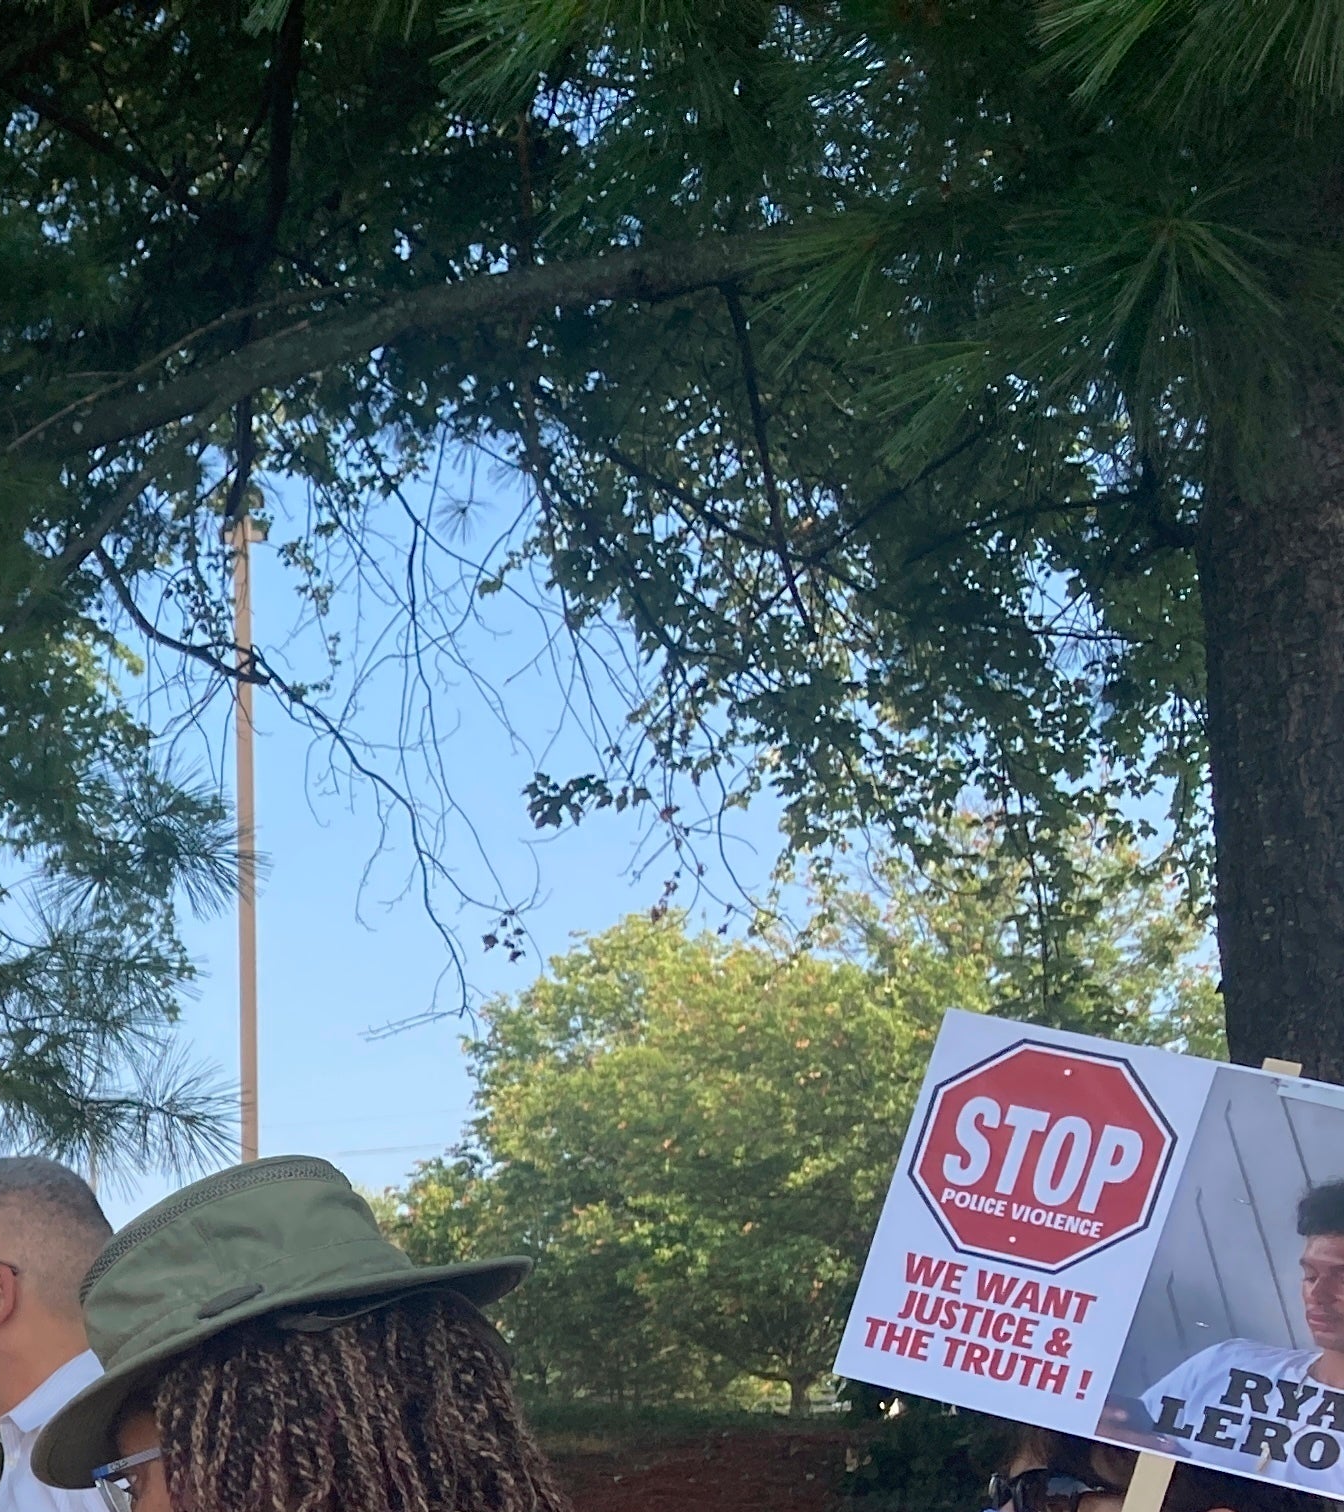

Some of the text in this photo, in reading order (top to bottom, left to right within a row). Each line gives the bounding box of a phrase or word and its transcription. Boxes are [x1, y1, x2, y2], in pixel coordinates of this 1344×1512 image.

[943, 1095, 1144, 1214] STOP
[940, 1187, 1104, 1239] POLICE VIOLENCE
[905, 1252, 1098, 1324] WE WANT
[864, 1316, 935, 1362] THE
[897, 1290, 1073, 1358] JUSTICE &
[1152, 1395, 1341, 1471] LERO
